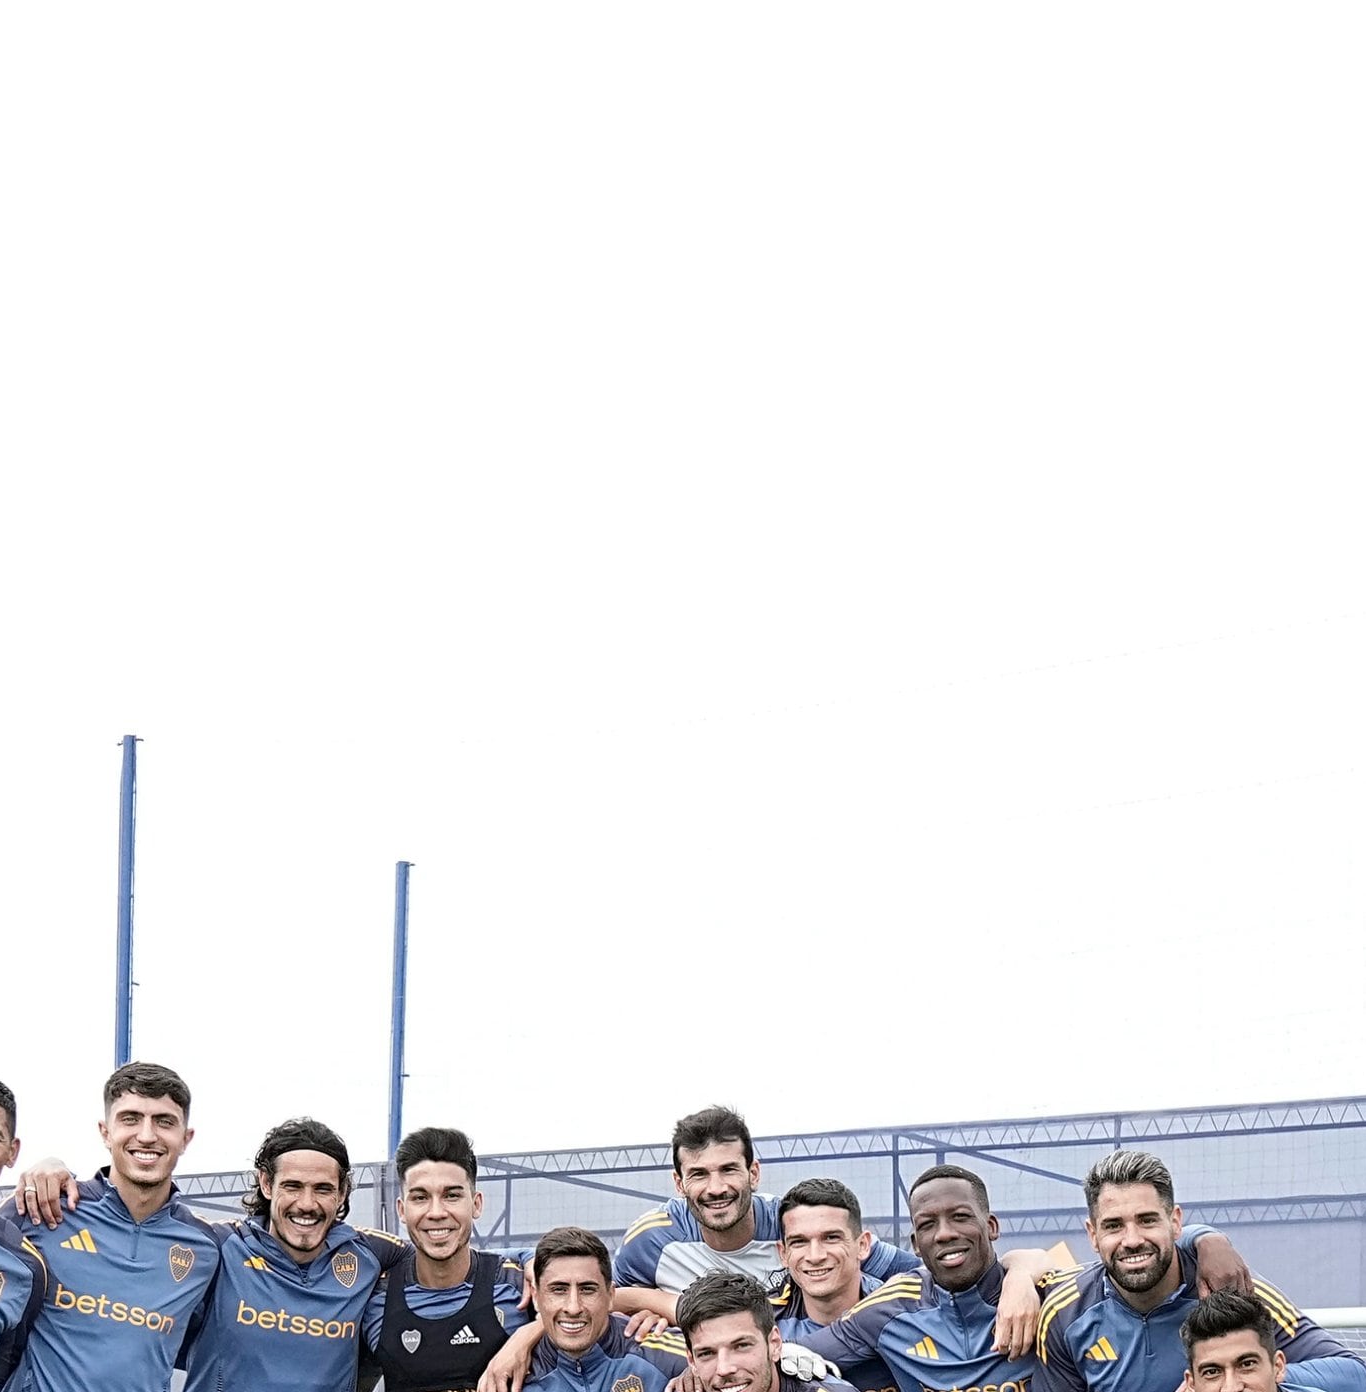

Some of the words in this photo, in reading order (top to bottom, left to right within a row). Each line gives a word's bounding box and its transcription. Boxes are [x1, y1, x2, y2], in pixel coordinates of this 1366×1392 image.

[336, 1262, 356, 1273] CABJ
[55, 1283, 175, 1336] betsson
[236, 1299, 356, 1339] betsson
[450, 1335, 481, 1346] adidas
